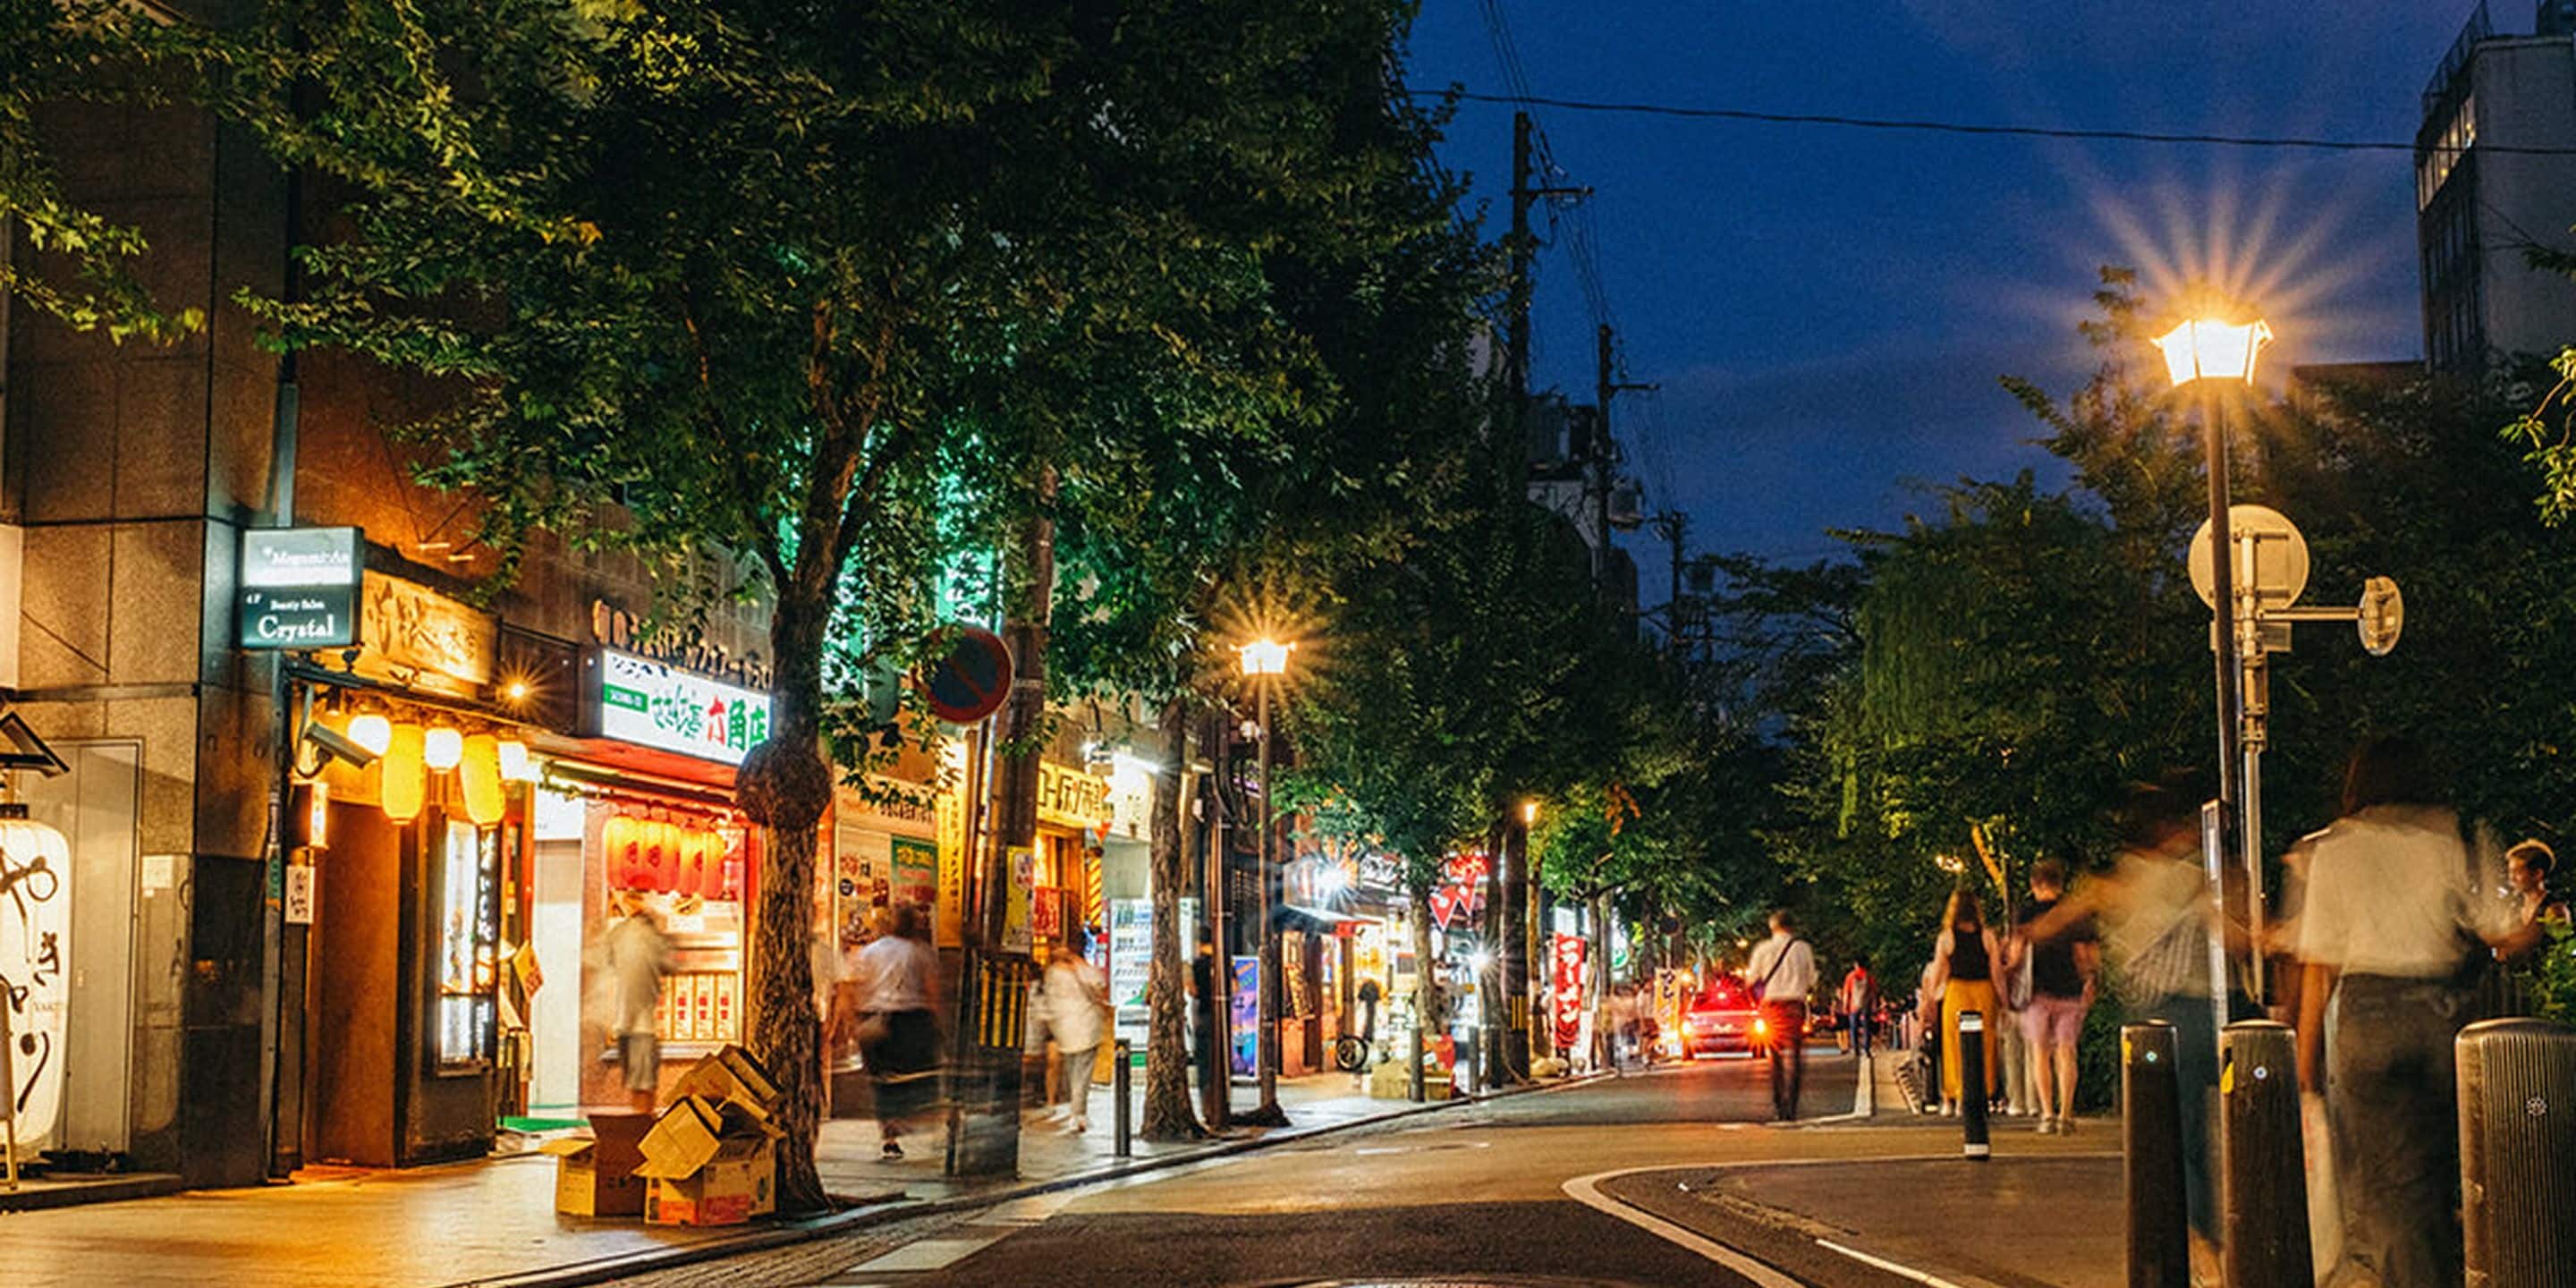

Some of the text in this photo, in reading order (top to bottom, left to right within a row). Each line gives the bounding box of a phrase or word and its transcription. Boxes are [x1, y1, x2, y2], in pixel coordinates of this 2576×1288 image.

[258, 614, 335, 642] Crystal
[1557, 939, 1580, 1023] ラーメン
